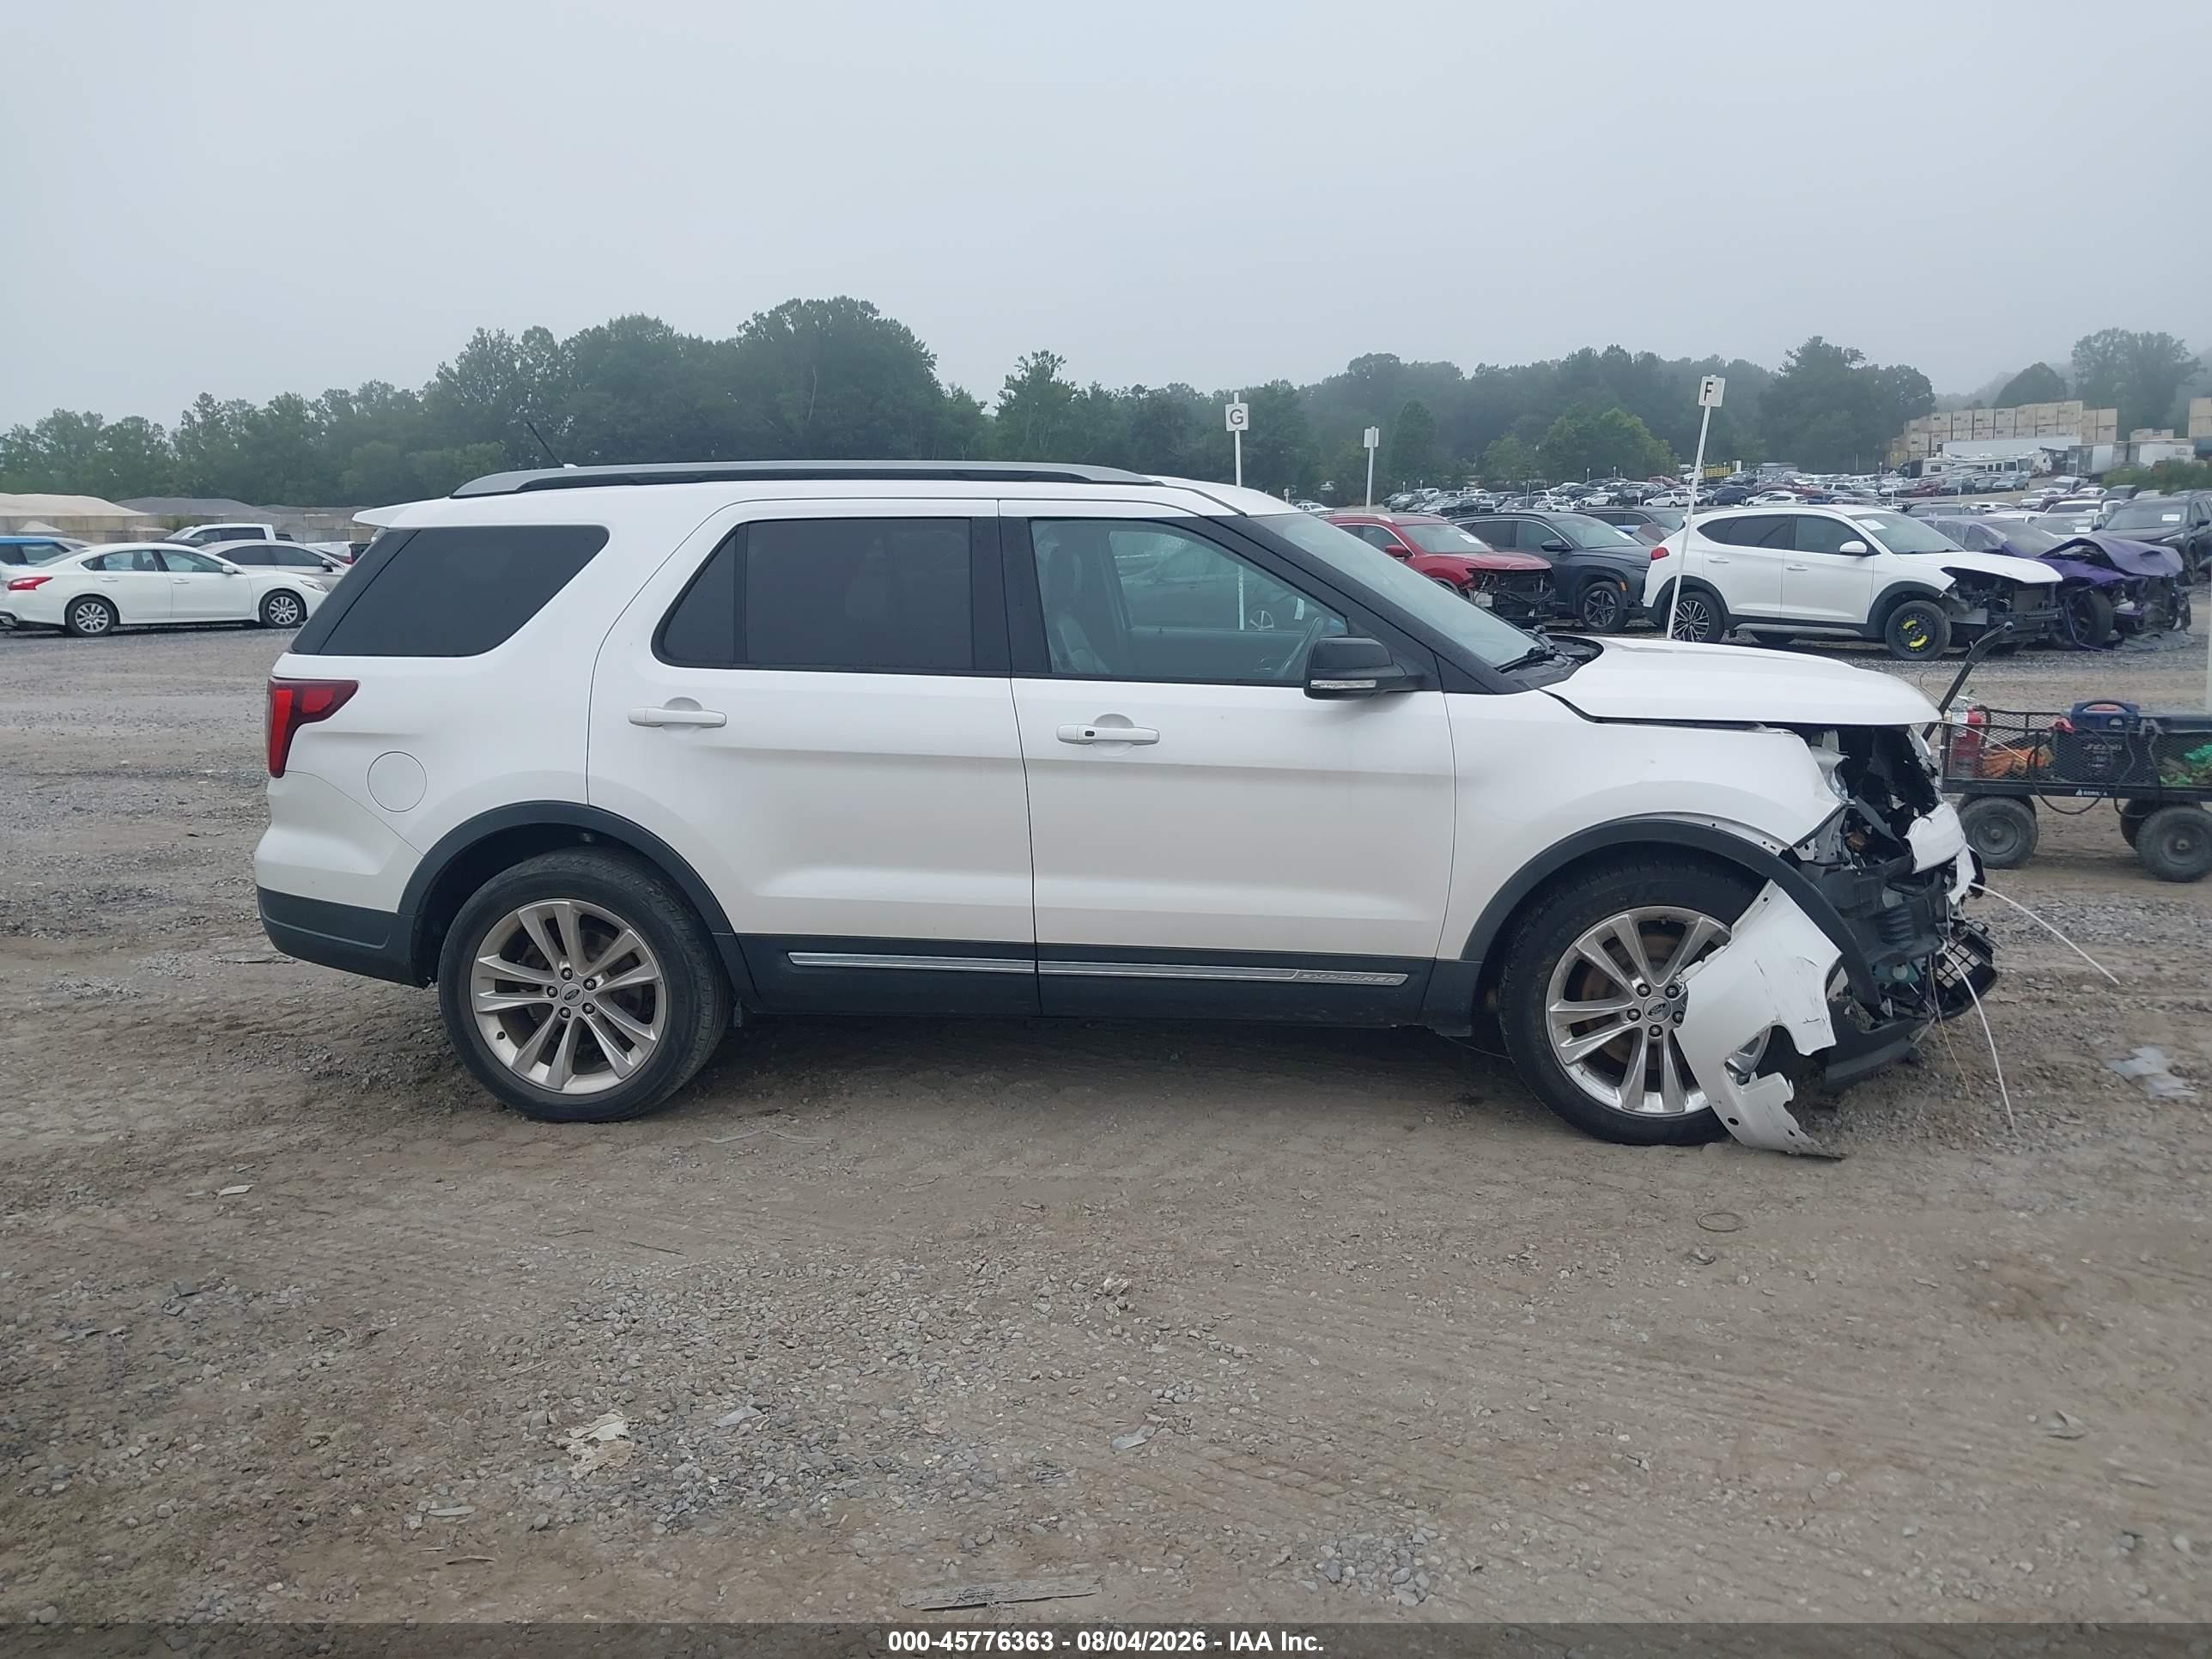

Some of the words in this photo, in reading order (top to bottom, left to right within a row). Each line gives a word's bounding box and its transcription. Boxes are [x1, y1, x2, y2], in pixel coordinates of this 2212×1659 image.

[1704, 381, 1713, 401] F
[1229, 409, 1244, 425] G
[1299, 974, 1398, 982] EXPLORER
